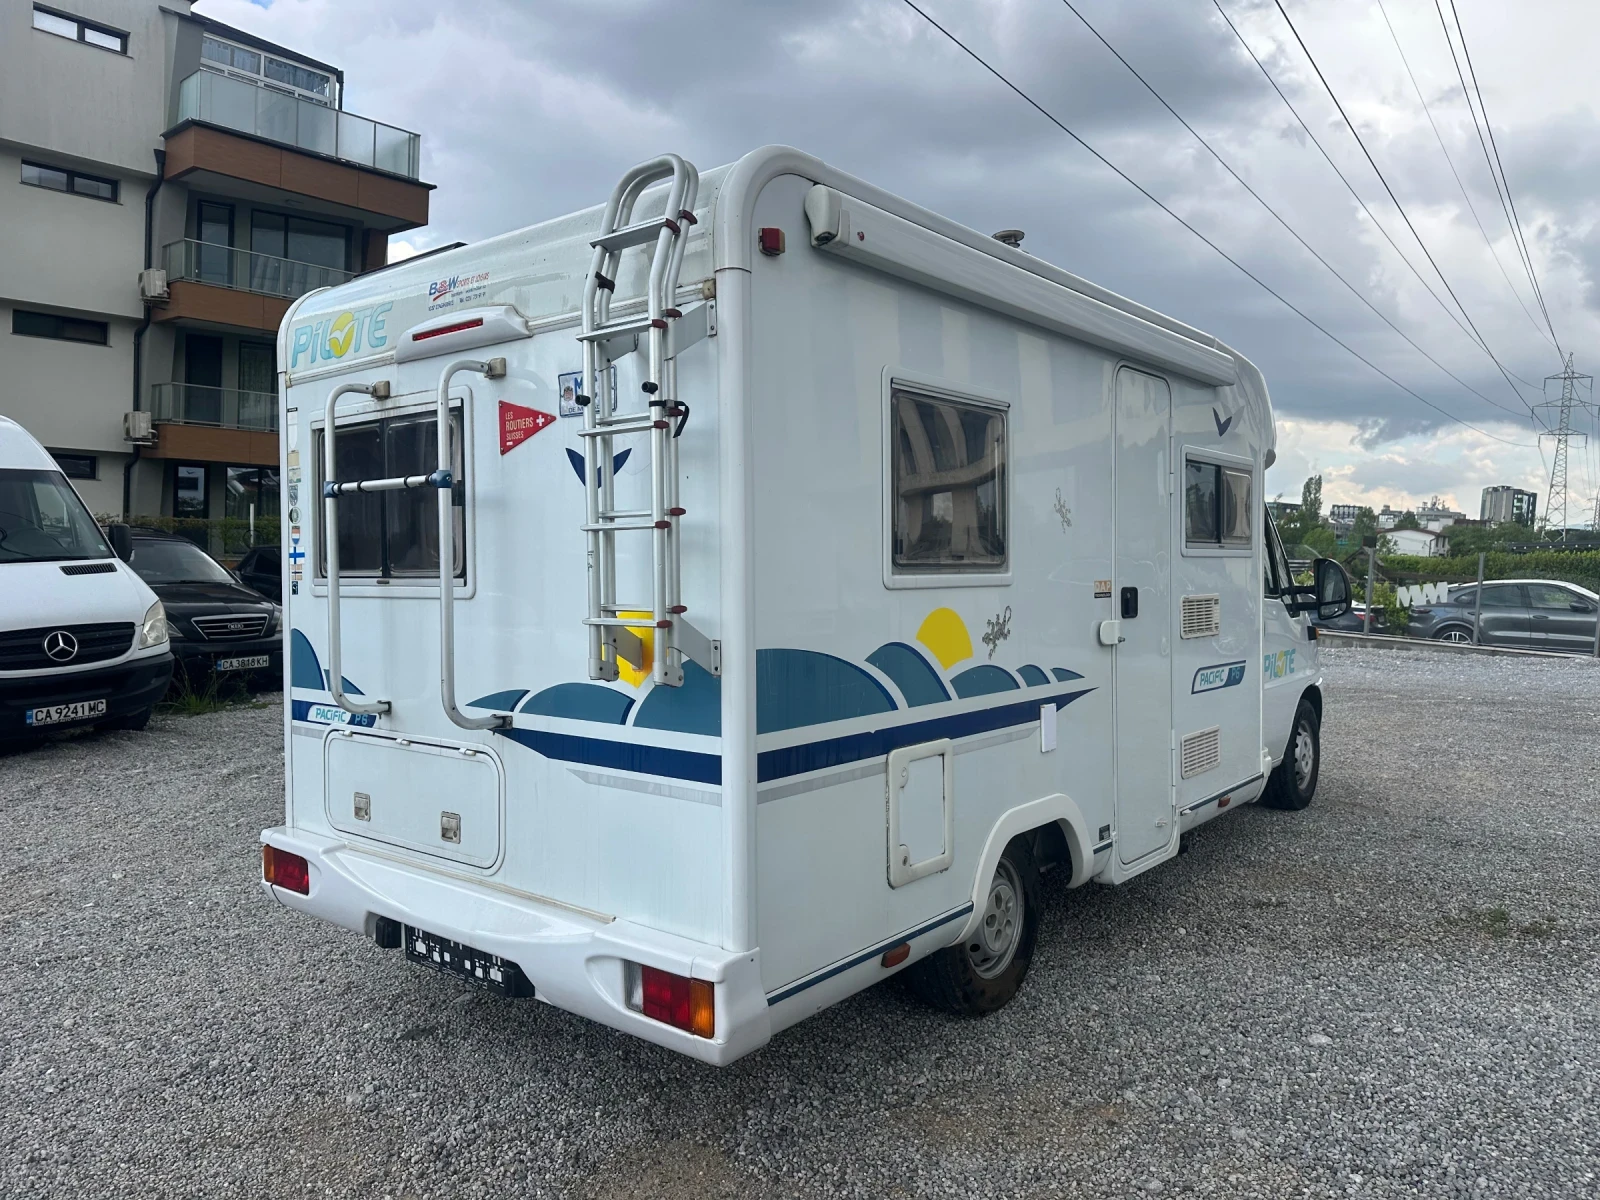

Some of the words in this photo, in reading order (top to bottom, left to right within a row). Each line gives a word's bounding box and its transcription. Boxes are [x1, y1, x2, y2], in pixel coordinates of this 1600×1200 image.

[429, 275, 459, 296] B&W
[505, 411, 514, 420] LES
[505, 417, 534, 431] ROUTIERS
[506, 430, 524, 440] SUISSES
[222, 660, 233, 669] CA
[257, 656, 268, 666] KH
[1231, 667, 1240, 680] P6
[35, 709, 52, 722] CA
[55, 703, 85, 719] 9241
[88, 701, 105, 714] MC
[354, 713, 368, 725] P6
